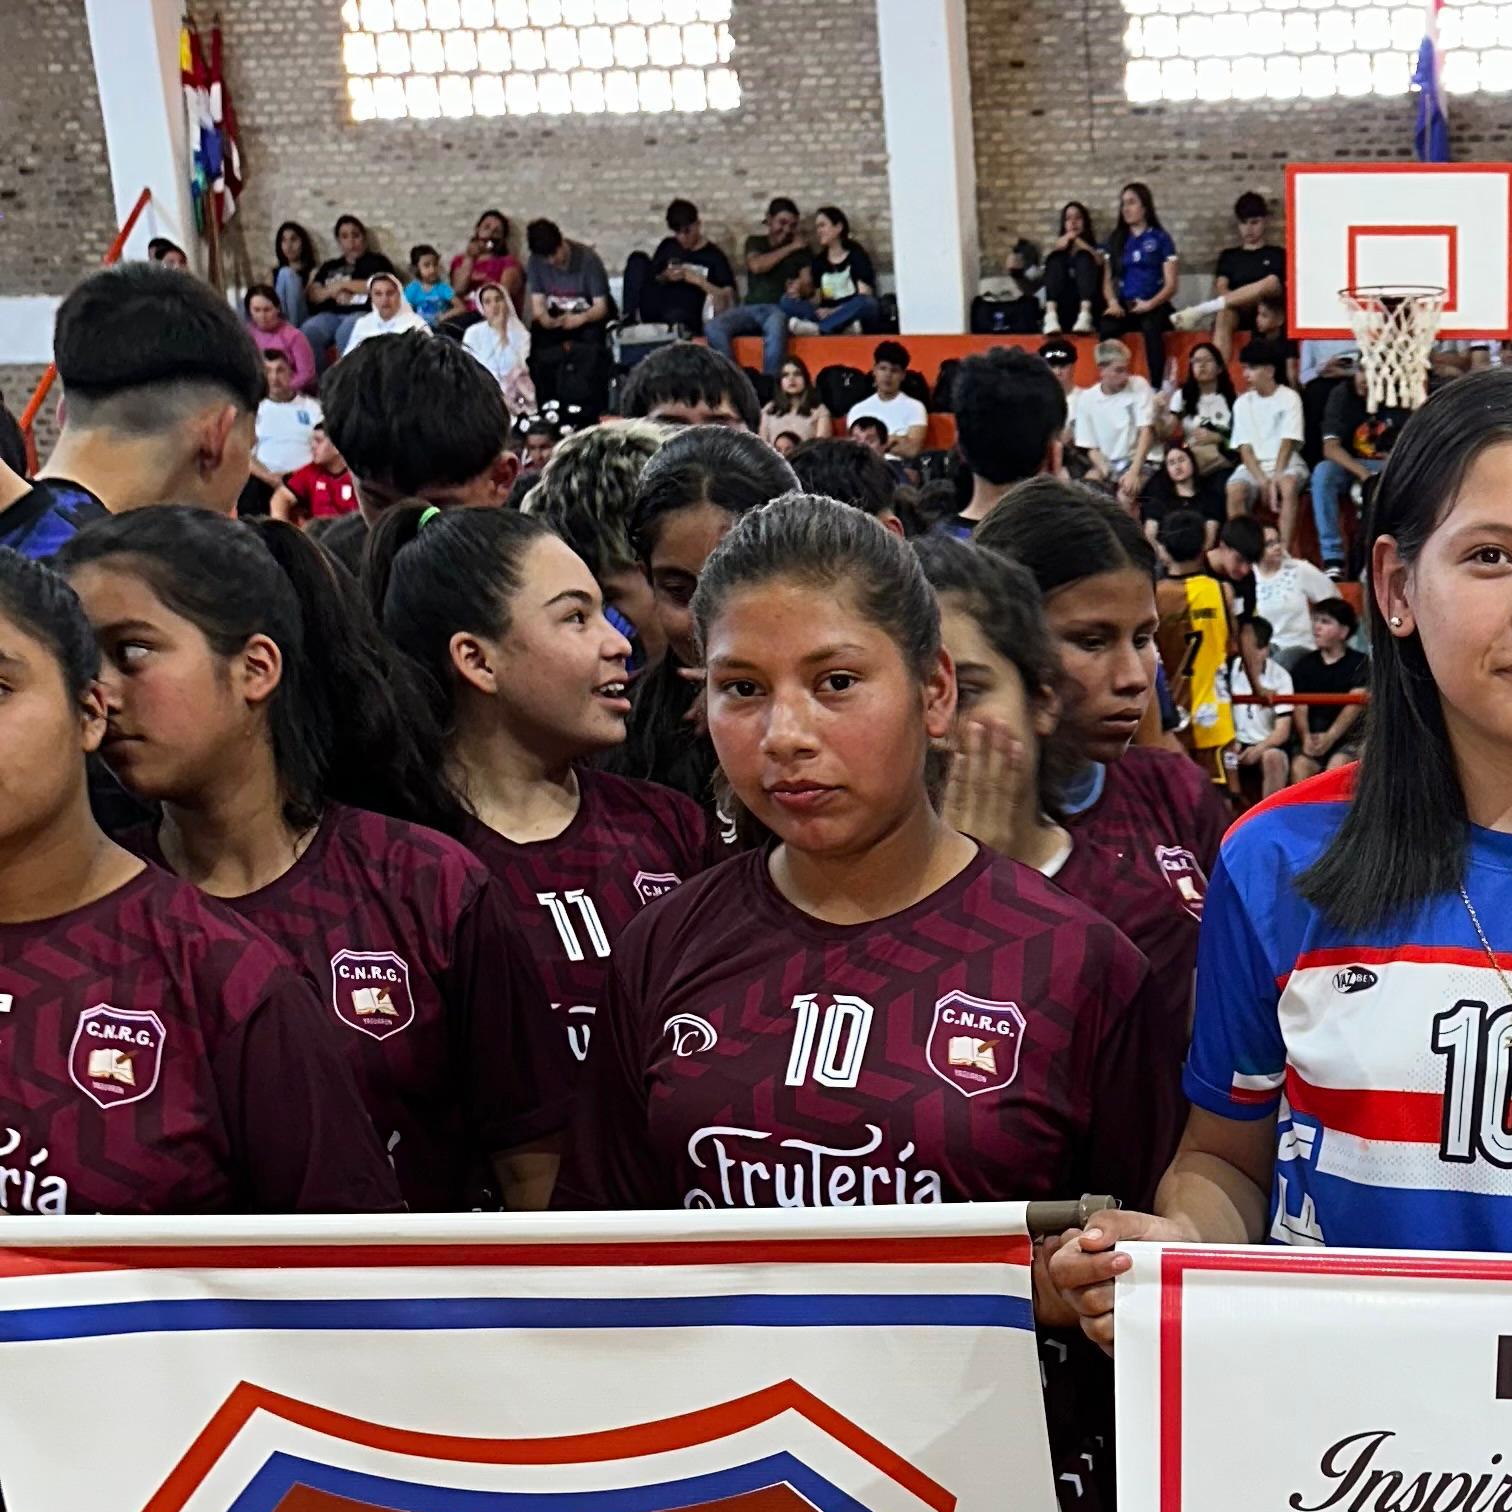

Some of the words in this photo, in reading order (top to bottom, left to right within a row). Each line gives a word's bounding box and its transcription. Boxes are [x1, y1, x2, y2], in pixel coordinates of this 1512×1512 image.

[1182, 629, 1204, 677] 7
[536, 888, 612, 962] 11
[338, 964, 402, 984] C.N.R.G.
[85, 1020, 155, 1048] C.N.R.G.
[784, 992, 875, 1089] 10
[941, 1007, 1016, 1038] C.N.R.G.
